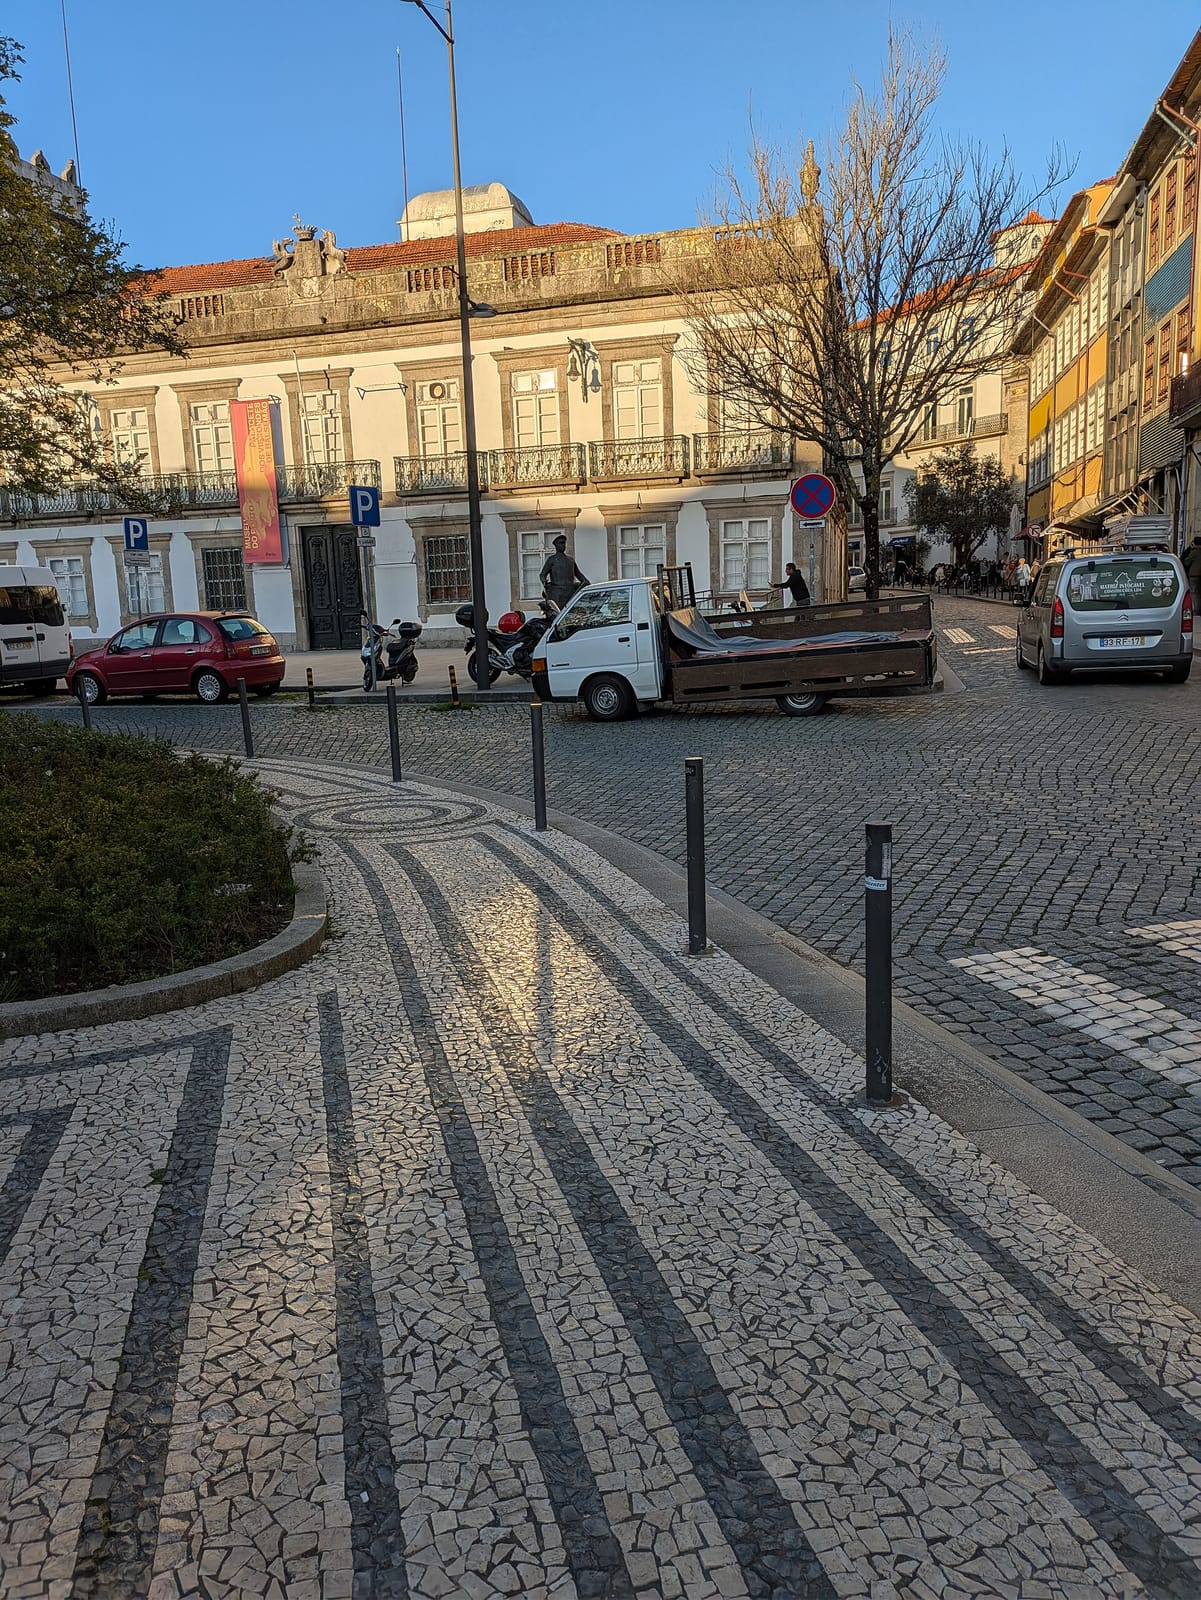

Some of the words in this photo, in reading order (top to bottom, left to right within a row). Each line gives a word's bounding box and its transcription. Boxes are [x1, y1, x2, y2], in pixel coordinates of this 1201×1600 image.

[246, 402, 256, 448] PALACETE
[265, 450, 272, 463] DE
[357, 490, 373, 522] P
[129, 520, 143, 547] P
[251, 535, 259, 549] DO
